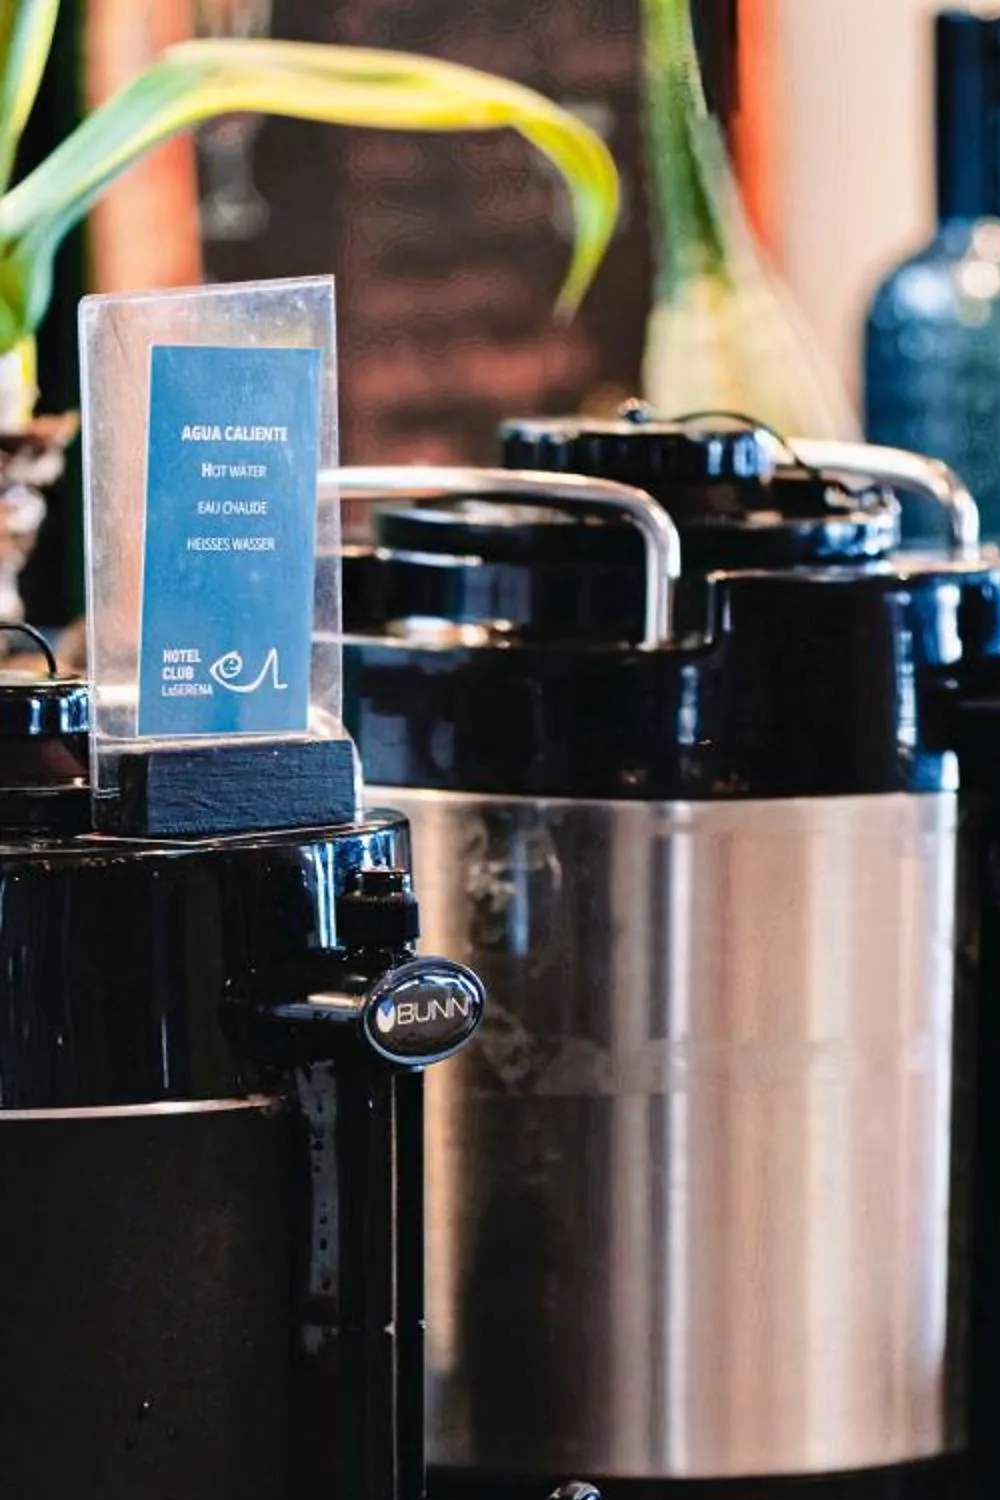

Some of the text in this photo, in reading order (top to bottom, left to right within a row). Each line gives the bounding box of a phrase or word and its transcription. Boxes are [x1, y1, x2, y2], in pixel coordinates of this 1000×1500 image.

[181, 425, 288, 442] AGUA CALIENTE
[201, 463, 267, 478] HOT WATER
[197, 502, 220, 515] EAU
[187, 538, 275, 551] HEISSES WASSER
[163, 649, 202, 663] HOTEL
[163, 666, 195, 680] CLUB
[397, 995, 470, 1025] BUNN
